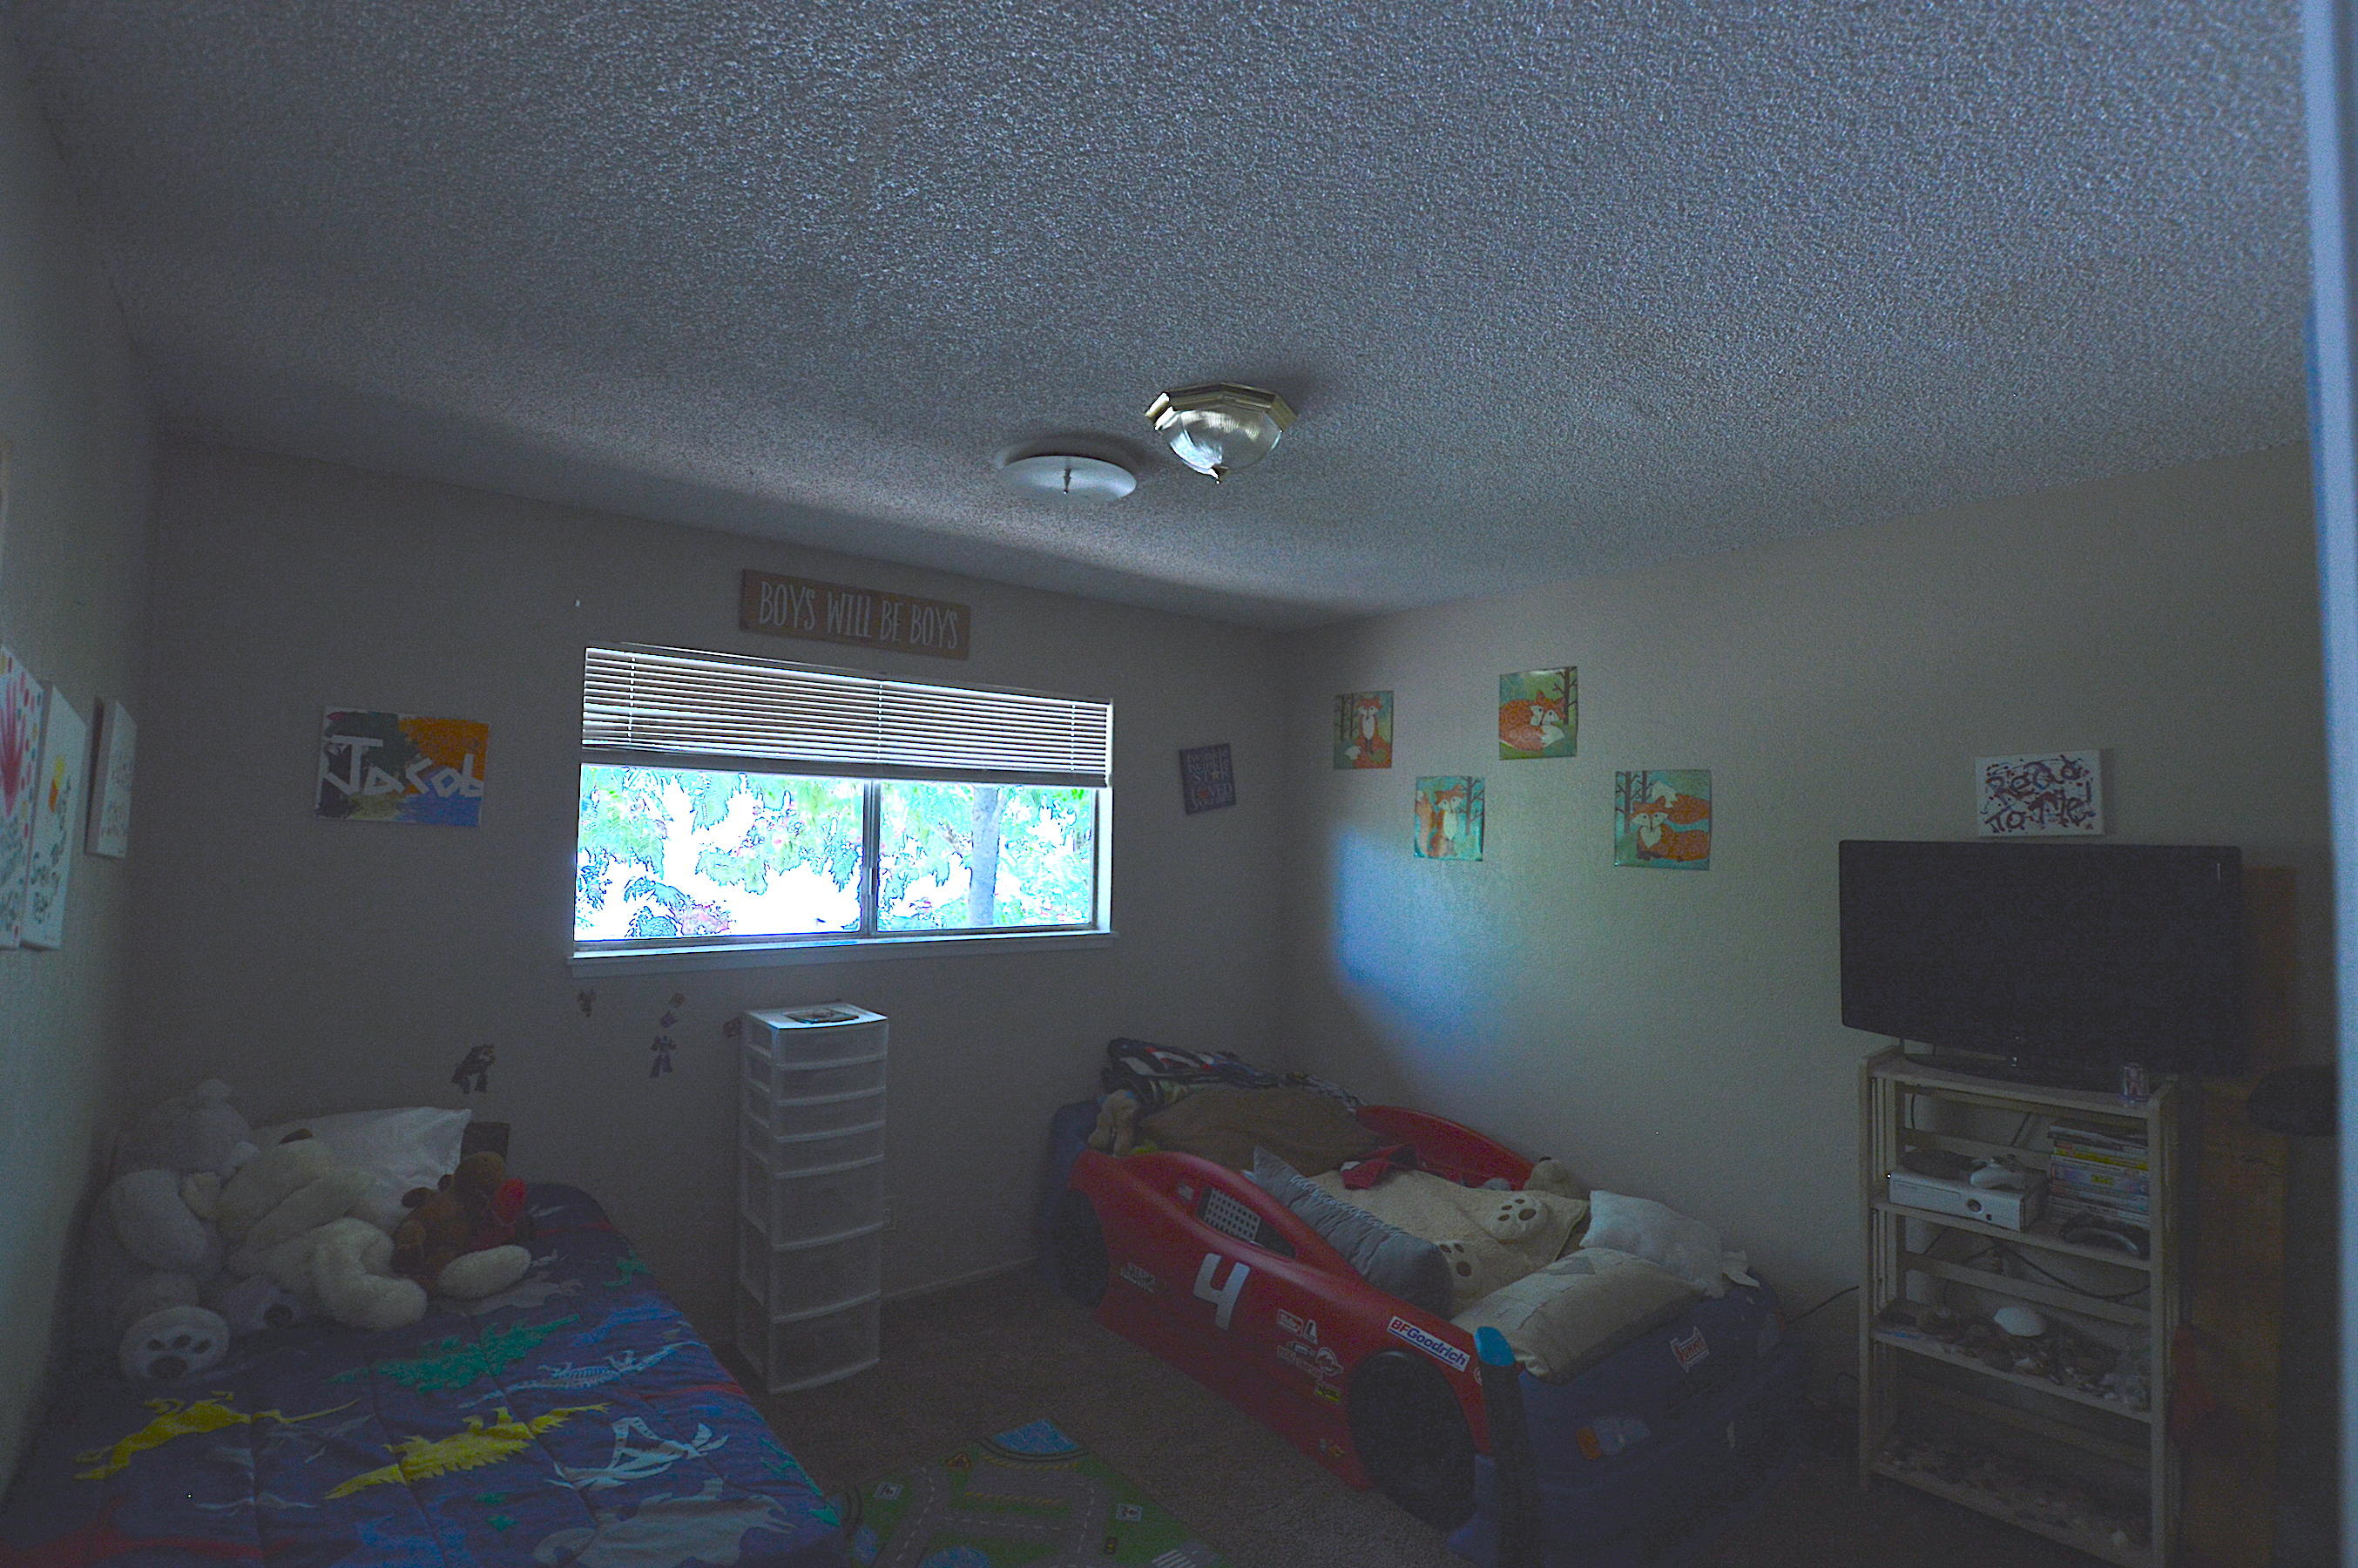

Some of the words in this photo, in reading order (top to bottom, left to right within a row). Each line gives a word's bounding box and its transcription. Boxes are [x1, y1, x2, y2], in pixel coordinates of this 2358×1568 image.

[759, 581, 816, 632] BOYS
[826, 591, 872, 638] WILL
[879, 599, 905, 642] BE
[909, 604, 959, 649] BOYS
[1193, 1253, 1251, 1330] 4
[1391, 1319, 1468, 1366] BFGoodrich
